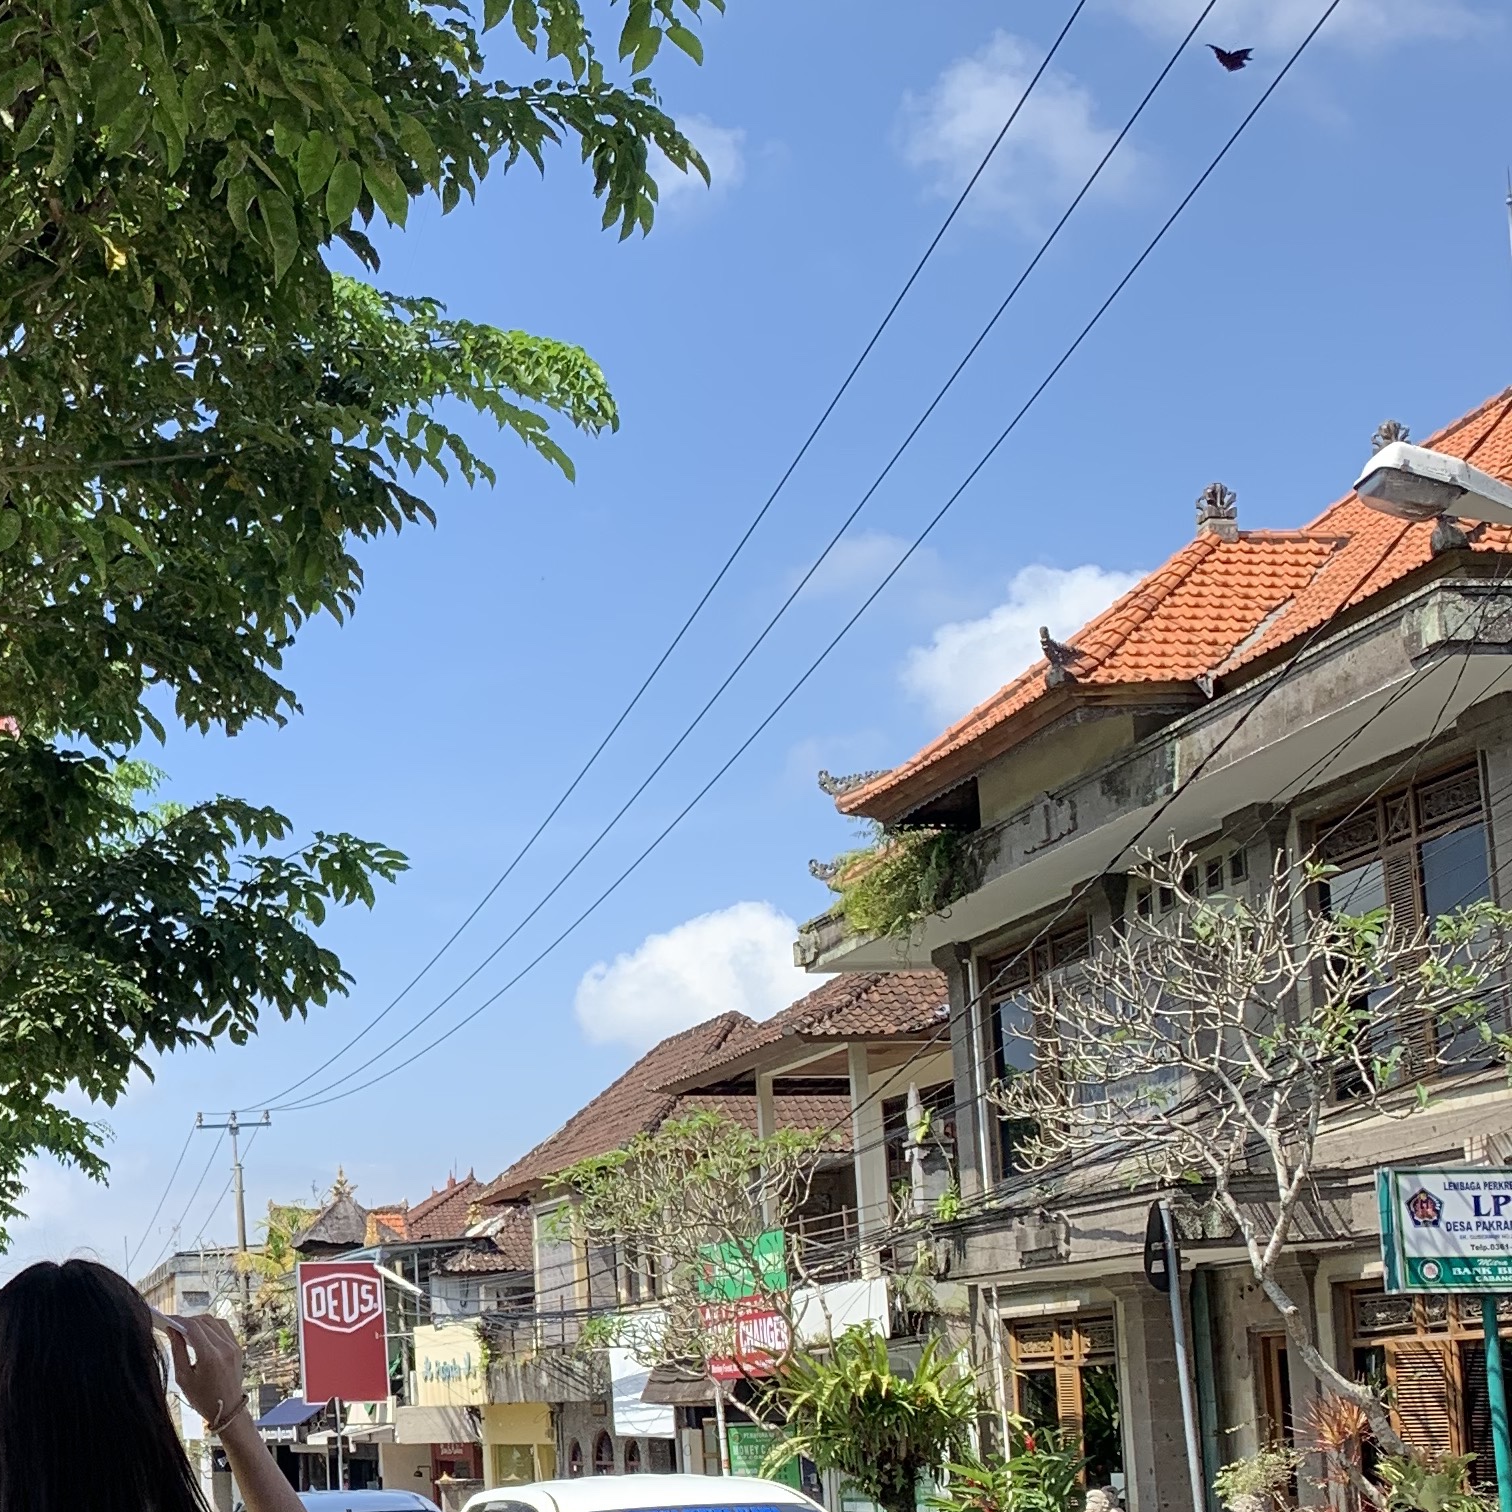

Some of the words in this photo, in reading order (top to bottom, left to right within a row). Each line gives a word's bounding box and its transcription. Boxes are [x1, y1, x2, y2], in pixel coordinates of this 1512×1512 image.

[1443, 1181, 1482, 1191] LEMBAGA
[1471, 1194, 1511, 1217] LP
[1445, 1221, 1473, 1232] DESA
[1452, 1267, 1492, 1275] BANK
